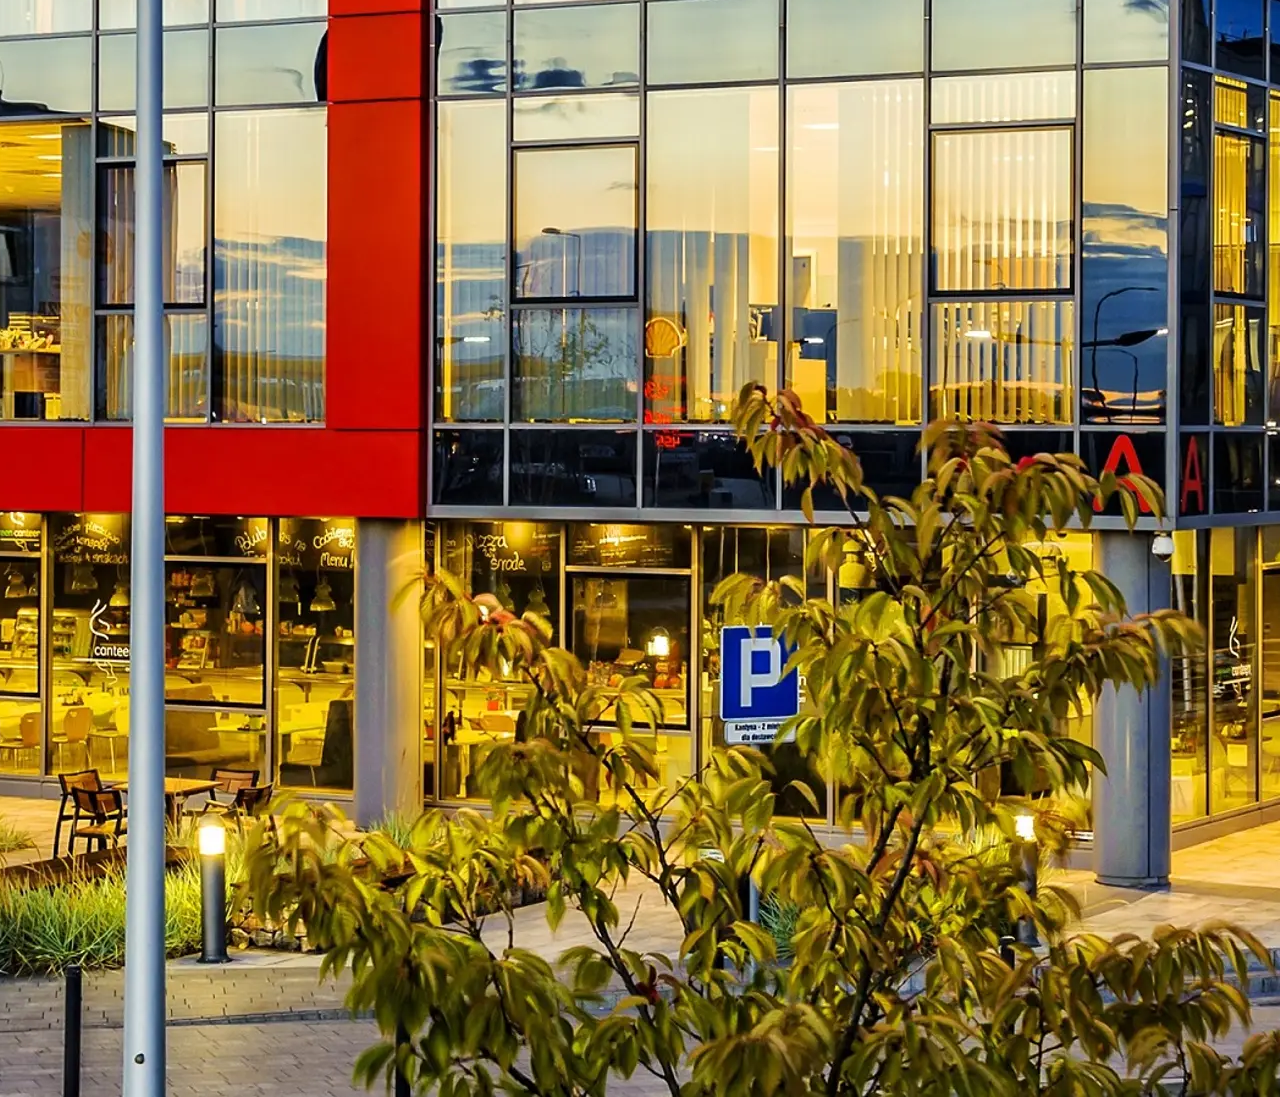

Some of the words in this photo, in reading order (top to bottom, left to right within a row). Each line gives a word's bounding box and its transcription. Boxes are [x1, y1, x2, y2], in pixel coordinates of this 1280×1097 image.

[1092, 434, 1151, 513] A
[1181, 435, 1205, 513] A
[94, 645, 131, 657] cantee
[740, 637, 782, 708] P
